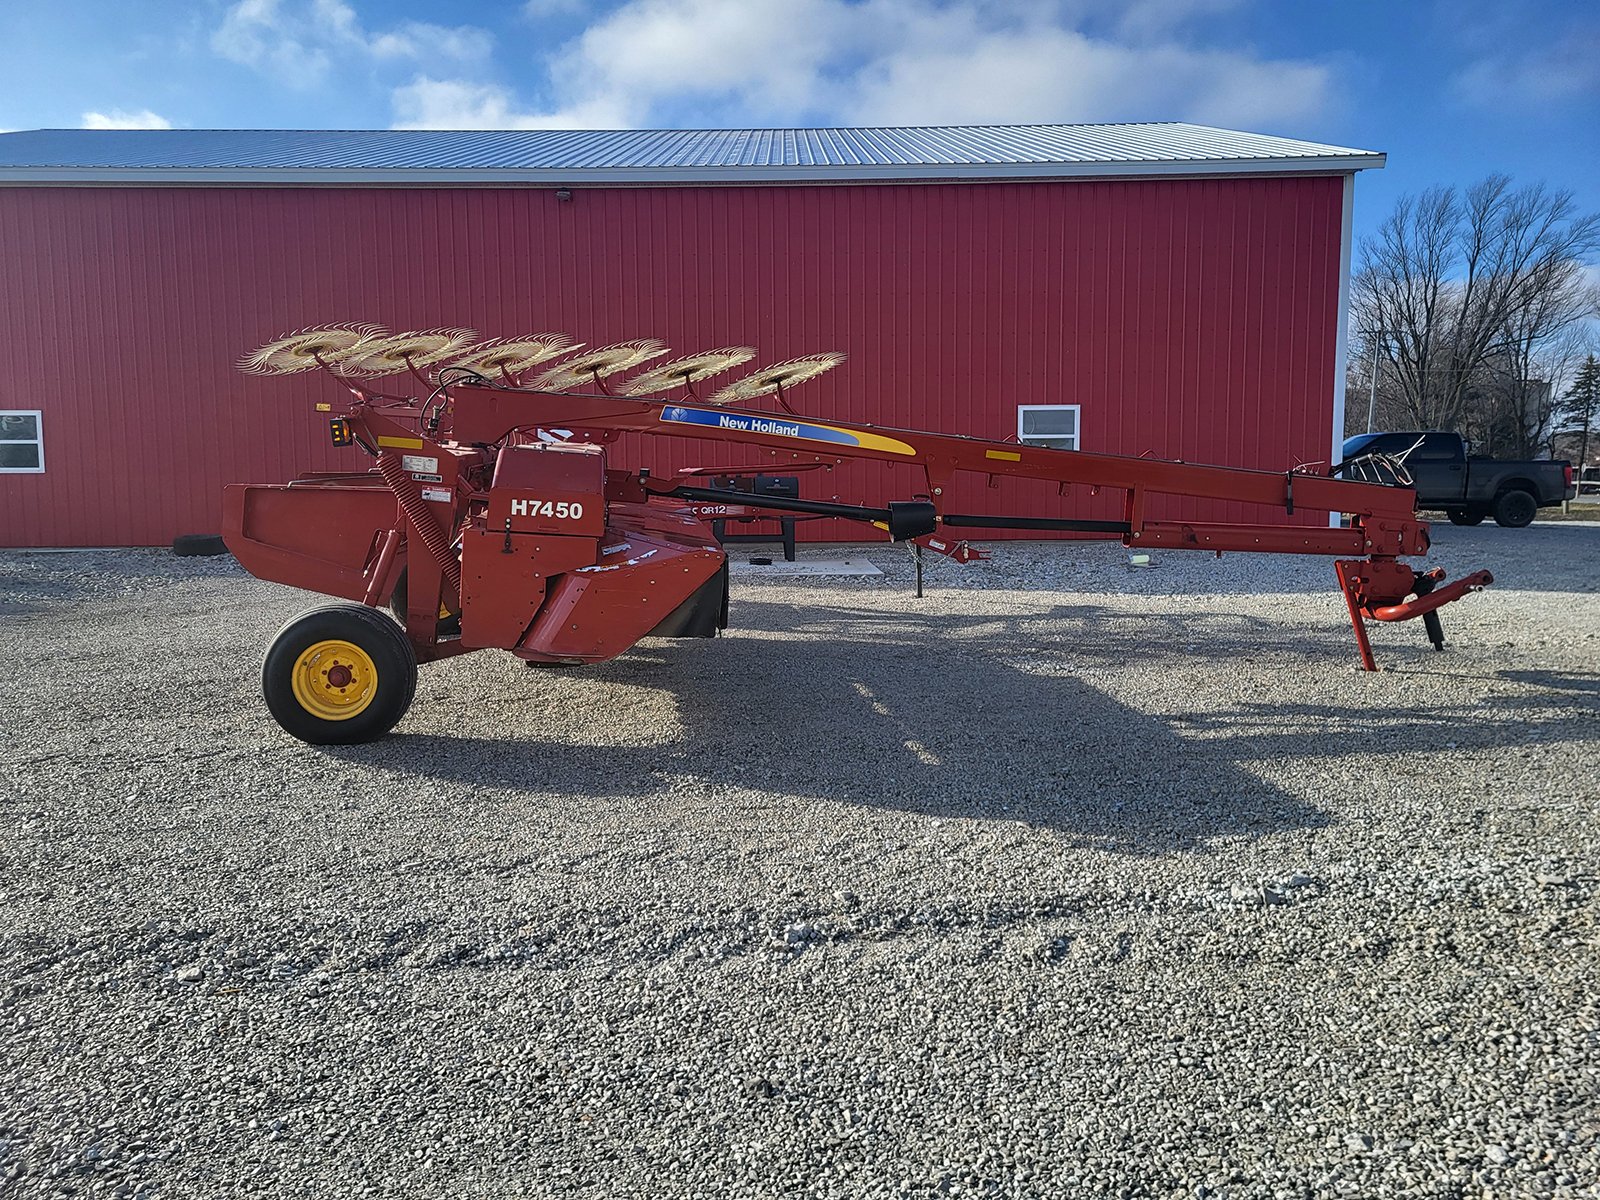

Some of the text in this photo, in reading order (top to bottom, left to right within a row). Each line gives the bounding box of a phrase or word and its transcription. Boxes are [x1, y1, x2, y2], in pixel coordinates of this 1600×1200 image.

[719, 415, 799, 437] New Holland
[511, 499, 583, 520] H7450
[700, 505, 726, 515] QR12
